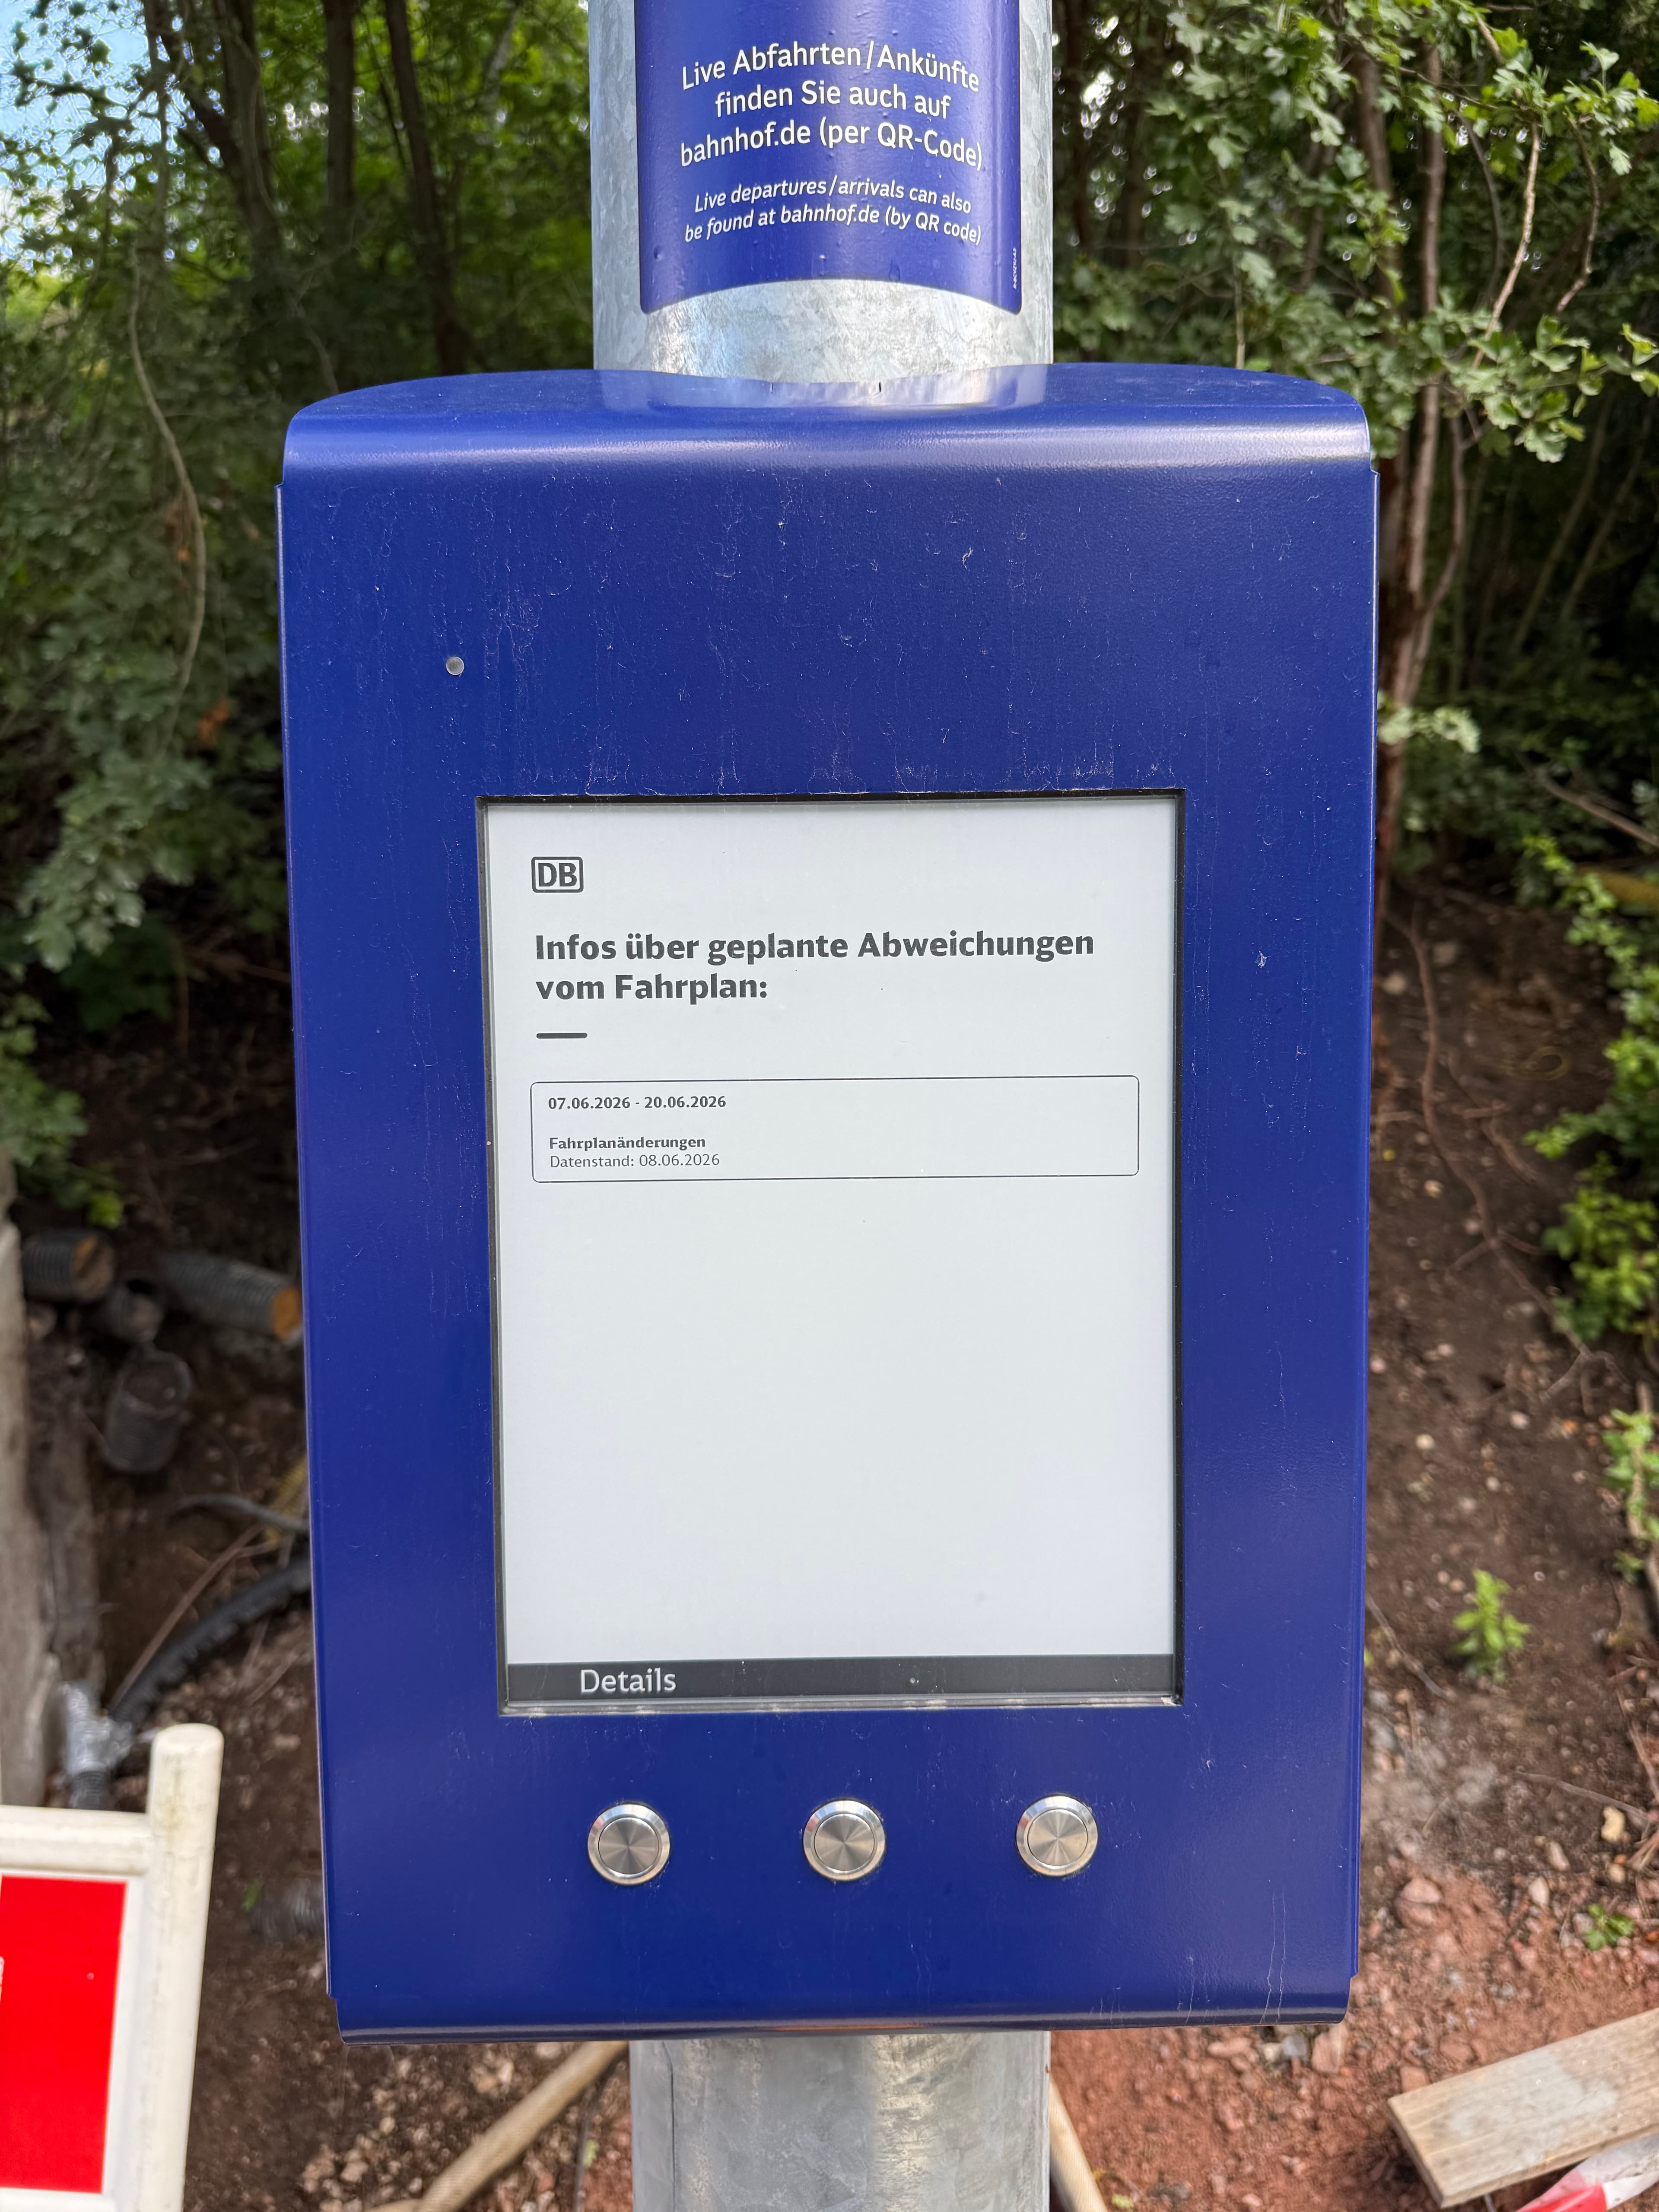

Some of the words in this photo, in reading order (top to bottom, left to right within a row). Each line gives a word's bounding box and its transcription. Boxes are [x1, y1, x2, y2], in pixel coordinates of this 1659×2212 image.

[682, 60, 726, 91] Live
[715, 84, 793, 118] finden
[801, 79, 841, 105] Sie
[849, 83, 907, 111] auch
[914, 94, 952, 119] auf
[680, 119, 811, 167] bahnhof.de
[820, 116, 871, 147] (per
[877, 122, 983, 170] QR-Code)
[694, 192, 727, 213] Live
[909, 188, 938, 205] can
[941, 191, 972, 214] also
[684, 224, 703, 243] be
[706, 213, 754, 241] found
[757, 208, 776, 226] at
[780, 203, 880, 226] bahnhof.de
[885, 205, 912, 230] (by
[915, 211, 940, 232] QR
[943, 219, 981, 245] code)
[537, 862, 578, 887] DB
[535, 933, 617, 960] Infos
[626, 932, 699, 960] über
[707, 932, 849, 966] geplante
[857, 929, 1094, 963] Abweichungen
[535, 980, 605, 1000] vom
[615, 972, 768, 1005] Fahrplan:
[548, 1096, 631, 1110] 07.06.2026
[644, 1095, 727, 1109] 20.06.2026
[549, 1136, 706, 1152] Fahrplanänderungen
[550, 1154, 634, 1168] Datenstand:
[639, 1153, 720, 1167] 08.06.2026
[580, 1667, 677, 1694] Details
